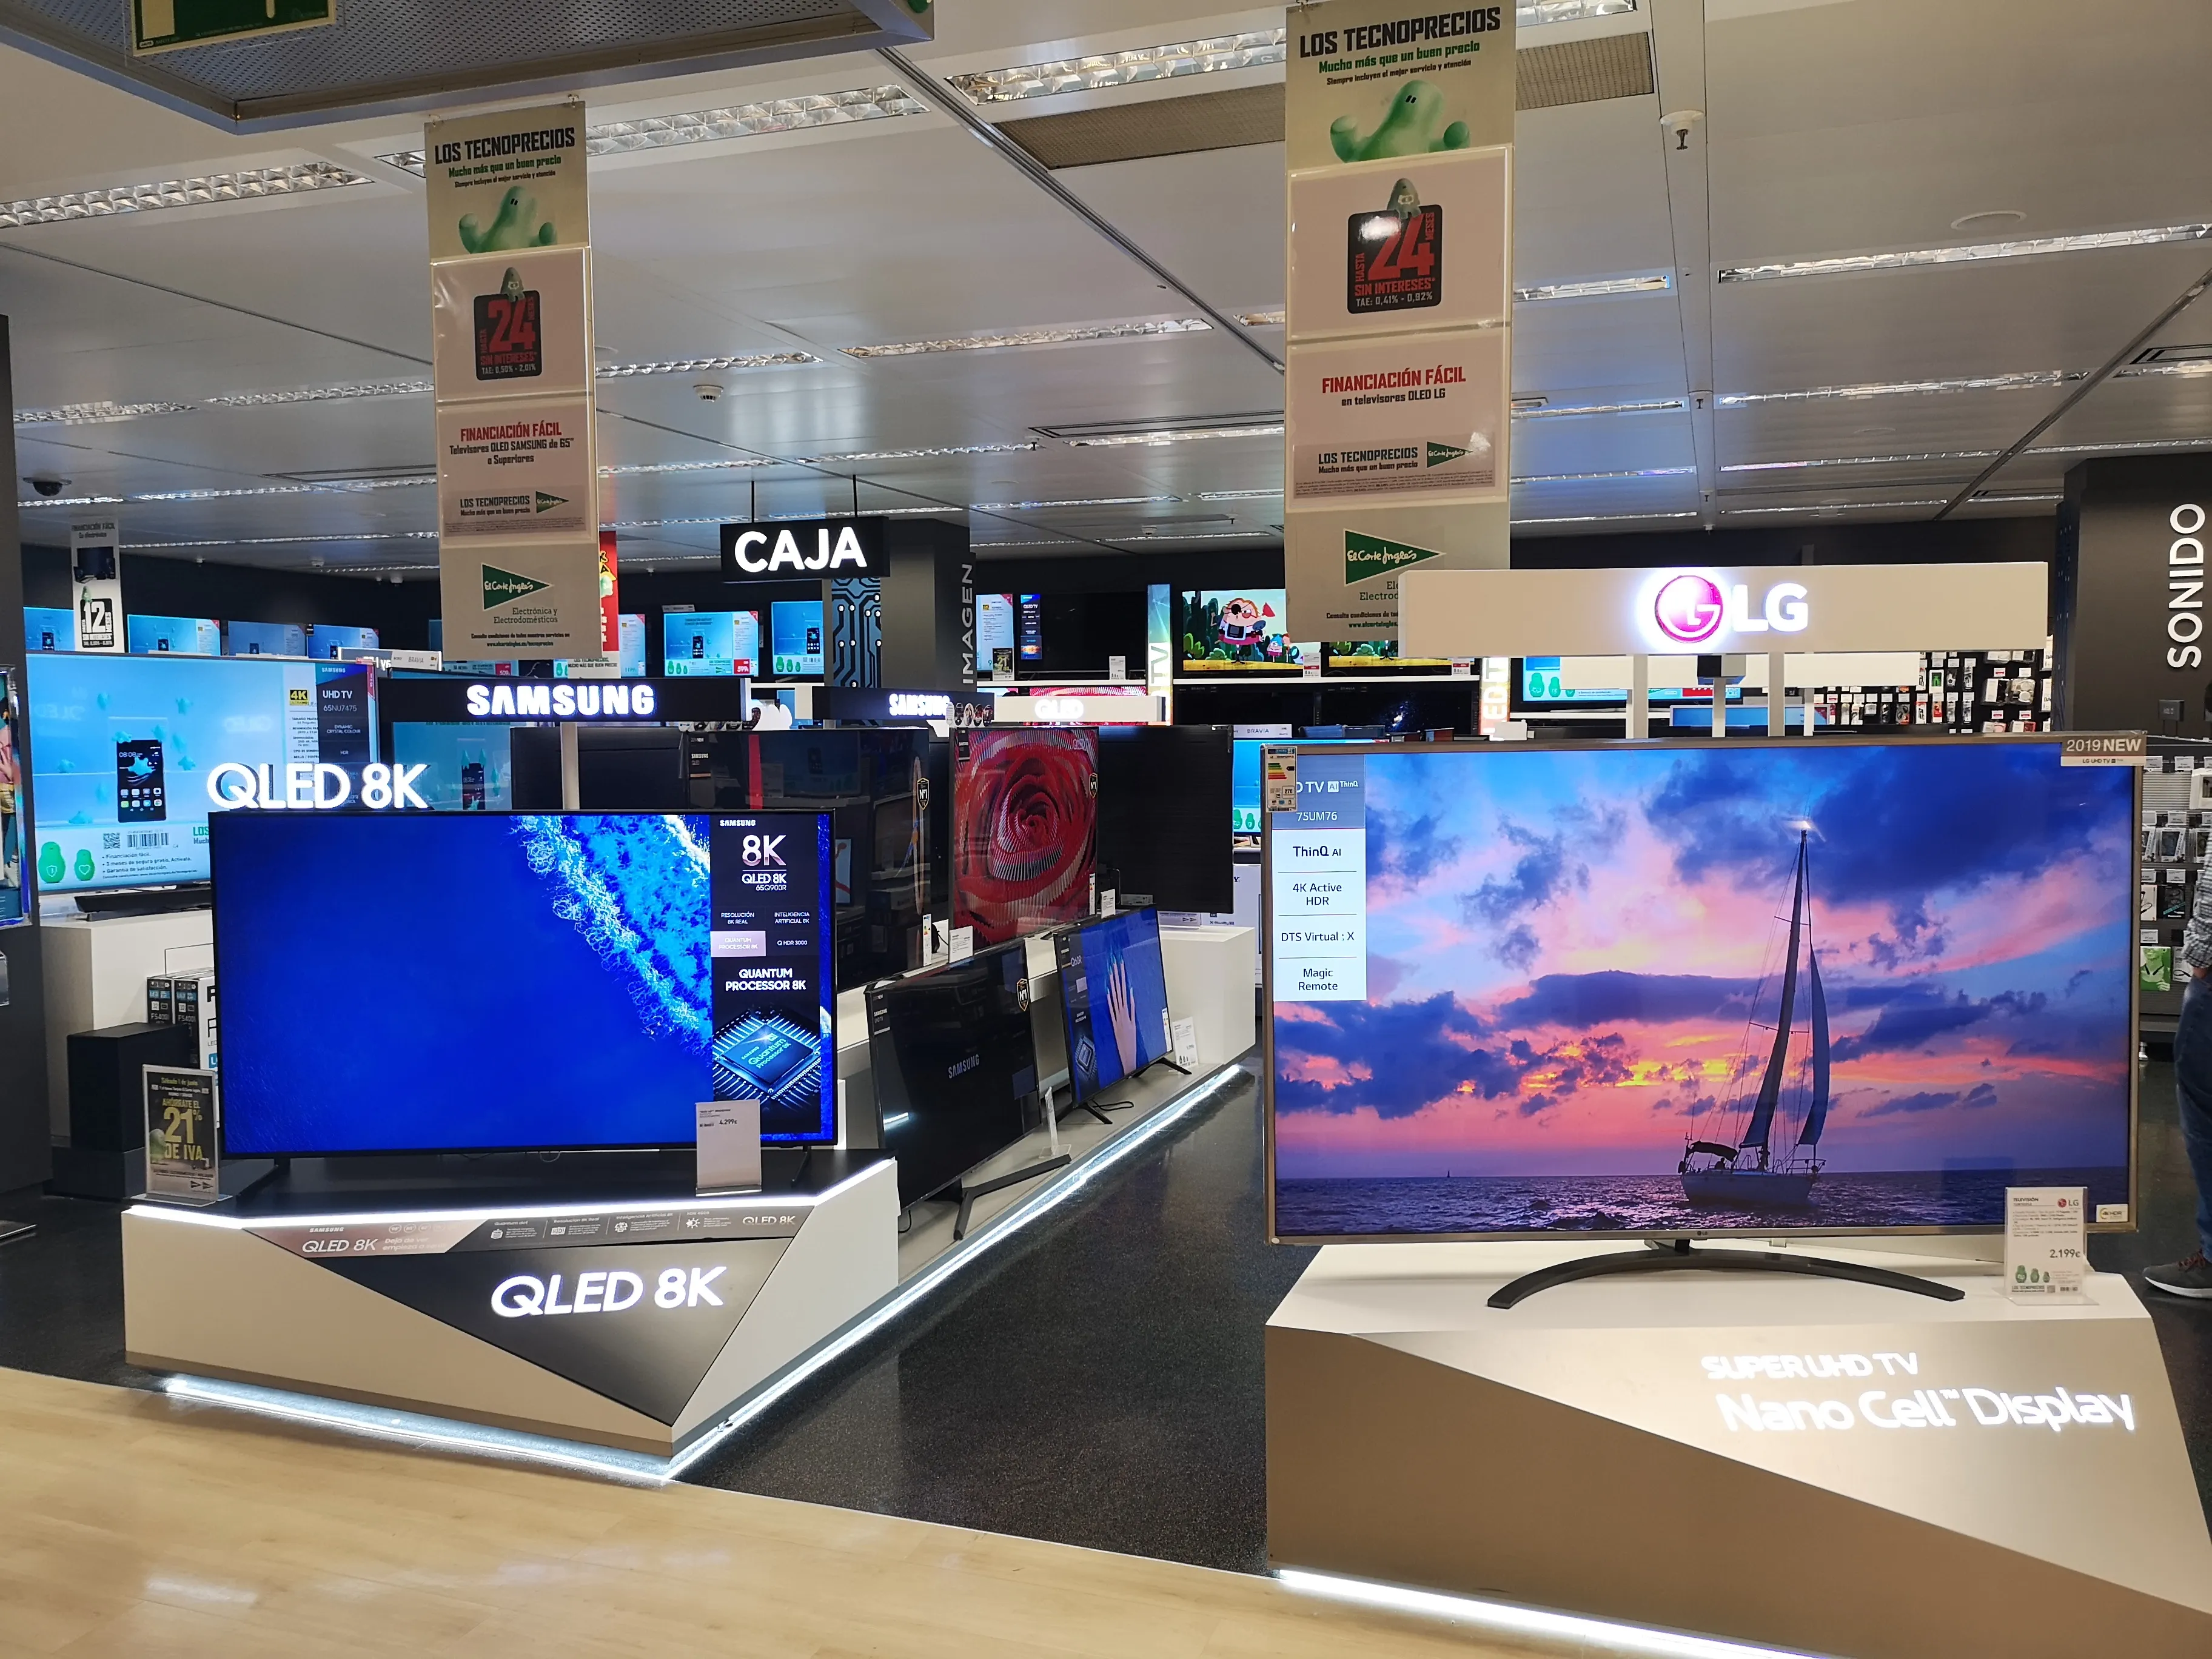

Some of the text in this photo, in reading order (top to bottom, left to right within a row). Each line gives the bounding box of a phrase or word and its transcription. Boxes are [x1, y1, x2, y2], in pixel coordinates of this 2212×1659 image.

[1300, 7, 1501, 58] LOS TECNOPRECIOS
[1319, 41, 1480, 73] Mucho más que un buen precio
[1327, 76, 1353, 85] Siempre
[1355, 73, 1381, 82] incluyen
[1390, 68, 1408, 77] mejor
[1410, 64, 1436, 73] servicio
[1443, 59, 1471, 69] atención
[435, 127, 575, 164] LOS TECNOPRECIOS
[449, 155, 561, 178] Mucho más que un buen precio
[1425, 212, 1435, 240] MESES
[1355, 252, 1365, 282] HASTA
[1355, 283, 1372, 297] SIN
[1356, 297, 1373, 307] TAE:
[488, 298, 536, 353] 24
[482, 366, 494, 375] TAE:
[1322, 365, 1466, 394] FINANCIACIÓN FÁCIL
[1341, 398, 1352, 406] en
[1355, 394, 1406, 405] televisores
[1434, 388, 1446, 399] LG
[461, 420, 562, 442] FINANCIACIÓN FÁCIL
[449, 444, 489, 455] Televisores
[511, 439, 547, 451] SAMSUNG
[549, 438, 558, 449] de
[1318, 447, 1418, 464] LOS TECNOPRECIOS
[494, 454, 534, 466] Superiores
[1318, 465, 1339, 474] Mucho
[460, 498, 474, 508] LOS
[475, 495, 530, 508] TECNOPRECIOS
[734, 526, 868, 573] CAJA
[1347, 550, 1358, 561] El
[1358, 550, 1382, 561] Corte
[2167, 503, 2205, 668] SONIDO
[1732, 583, 1809, 632] LG
[84, 601, 106, 634] 12
[962, 563, 974, 685] IMAGEN
[1150, 645, 1168, 684] TV
[290, 691, 308, 701] 4K
[323, 690, 353, 699] UHD TV
[466, 684, 655, 716] SAMSUNG
[889, 693, 950, 716] SAMSUNG
[2066, 738, 2142, 752] 2019 NEW
[207, 762, 429, 809] QLED 8K
[1305, 782, 1324, 793] TV
[1296, 811, 1338, 822] 75UM76
[742, 834, 786, 866] 8K
[1293, 845, 1342, 858] ThinQ AI
[742, 873, 787, 884] QLED 8K
[1292, 882, 1342, 893] 4K Active
[1305, 896, 1330, 906] HDR
[1281, 931, 1355, 942] DTS Virtual X
[739, 968, 793, 979] QUANTUM
[1302, 968, 1334, 979] Magic
[725, 980, 806, 991] PROCESSOR 8K
[1298, 982, 1338, 991] Remote
[748, 1039, 786, 1065] Quantum
[948, 1054, 980, 1079] SAMSUNG
[165, 1142, 203, 1161] DE IVA
[743, 1216, 777, 1225] QLED
[779, 1215, 796, 1225] 8K
[302, 1238, 378, 1253] QLED 8K
[2049, 1248, 2080, 1258] 2.199€
[491, 1266, 728, 1318] QLED 8K
[1701, 1352, 1919, 1379] SUPER UHD TV
[1715, 1393, 1855, 1432] Nano
[1962, 1387, 2136, 1432] Display
